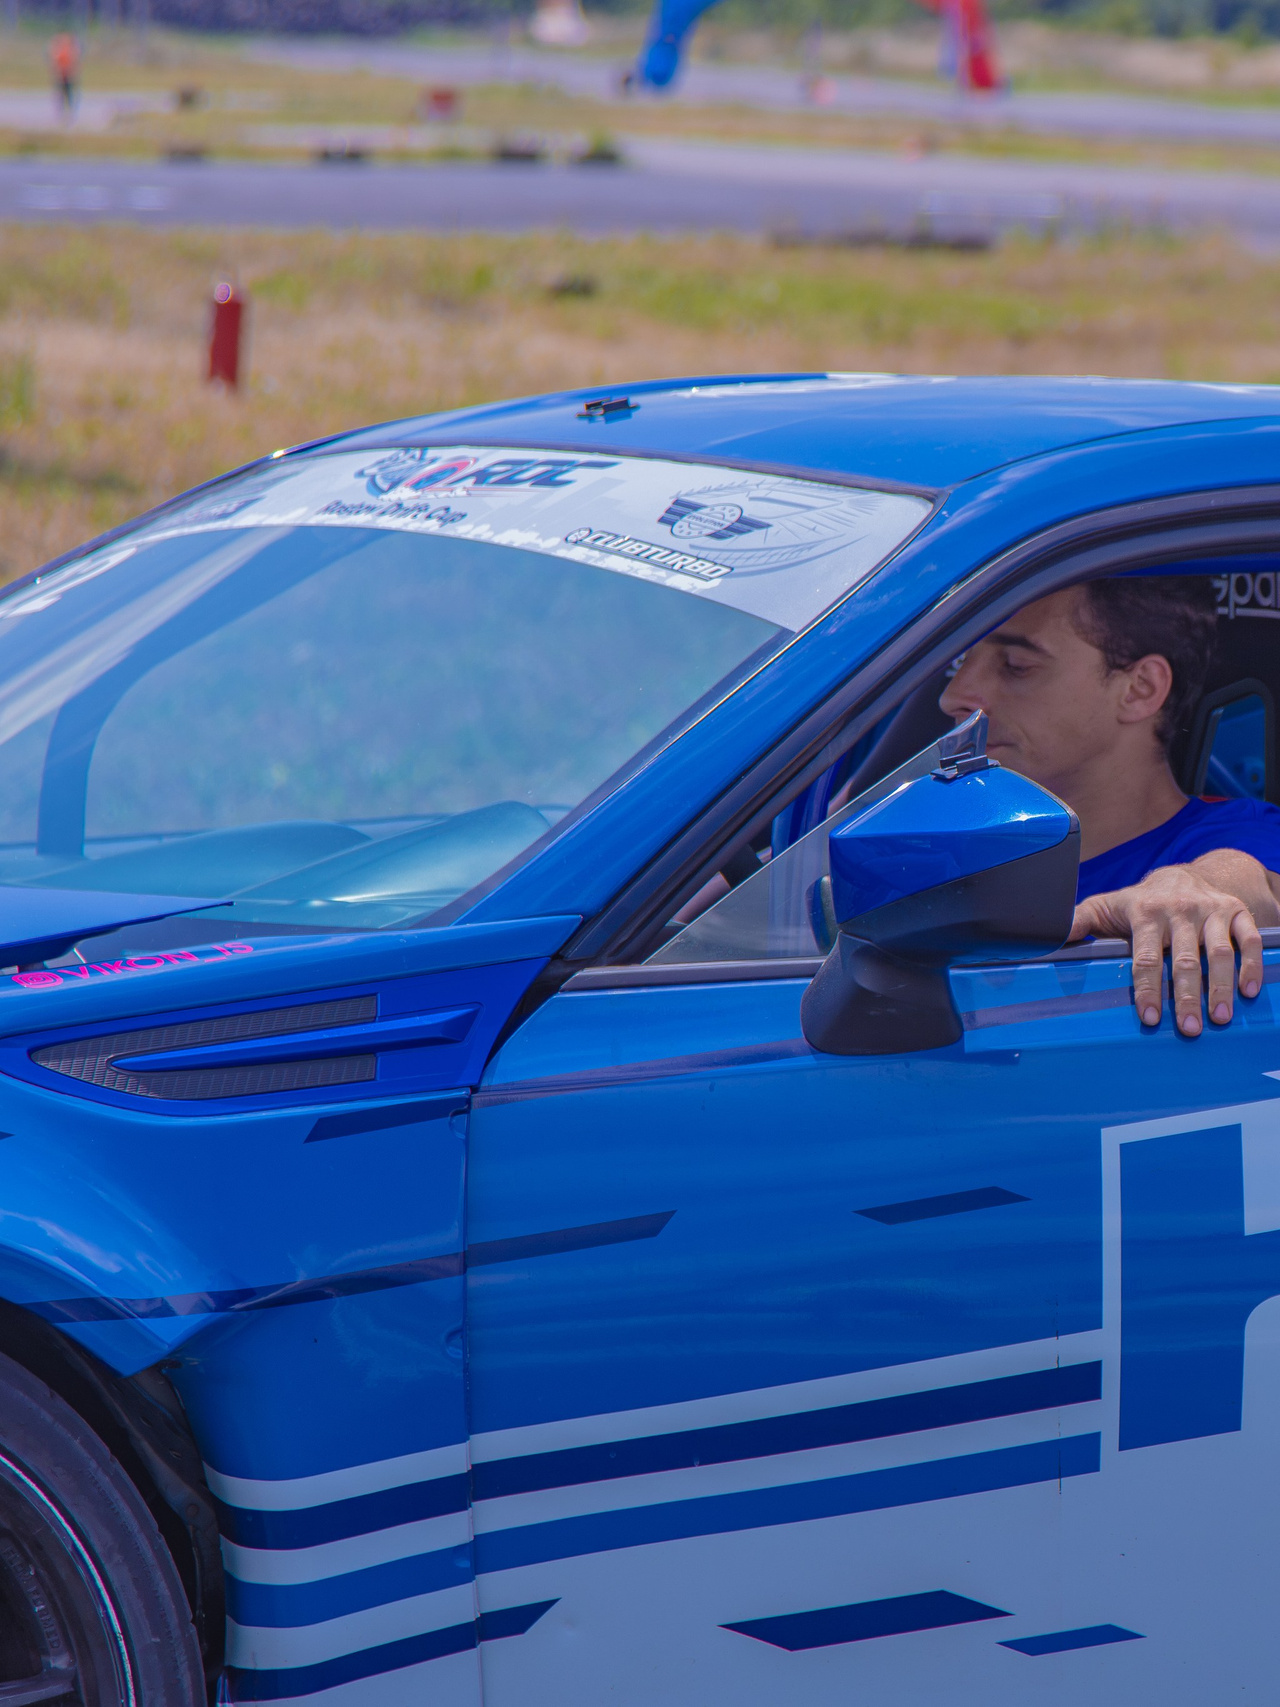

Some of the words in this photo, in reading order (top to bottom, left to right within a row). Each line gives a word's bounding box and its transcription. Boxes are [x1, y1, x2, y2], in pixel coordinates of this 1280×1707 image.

[316, 499, 382, 516] Rostov
[375, 501, 430, 521] Drift
[425, 505, 469, 528] Cup
[582, 530, 734, 579] CLUBTURBO
